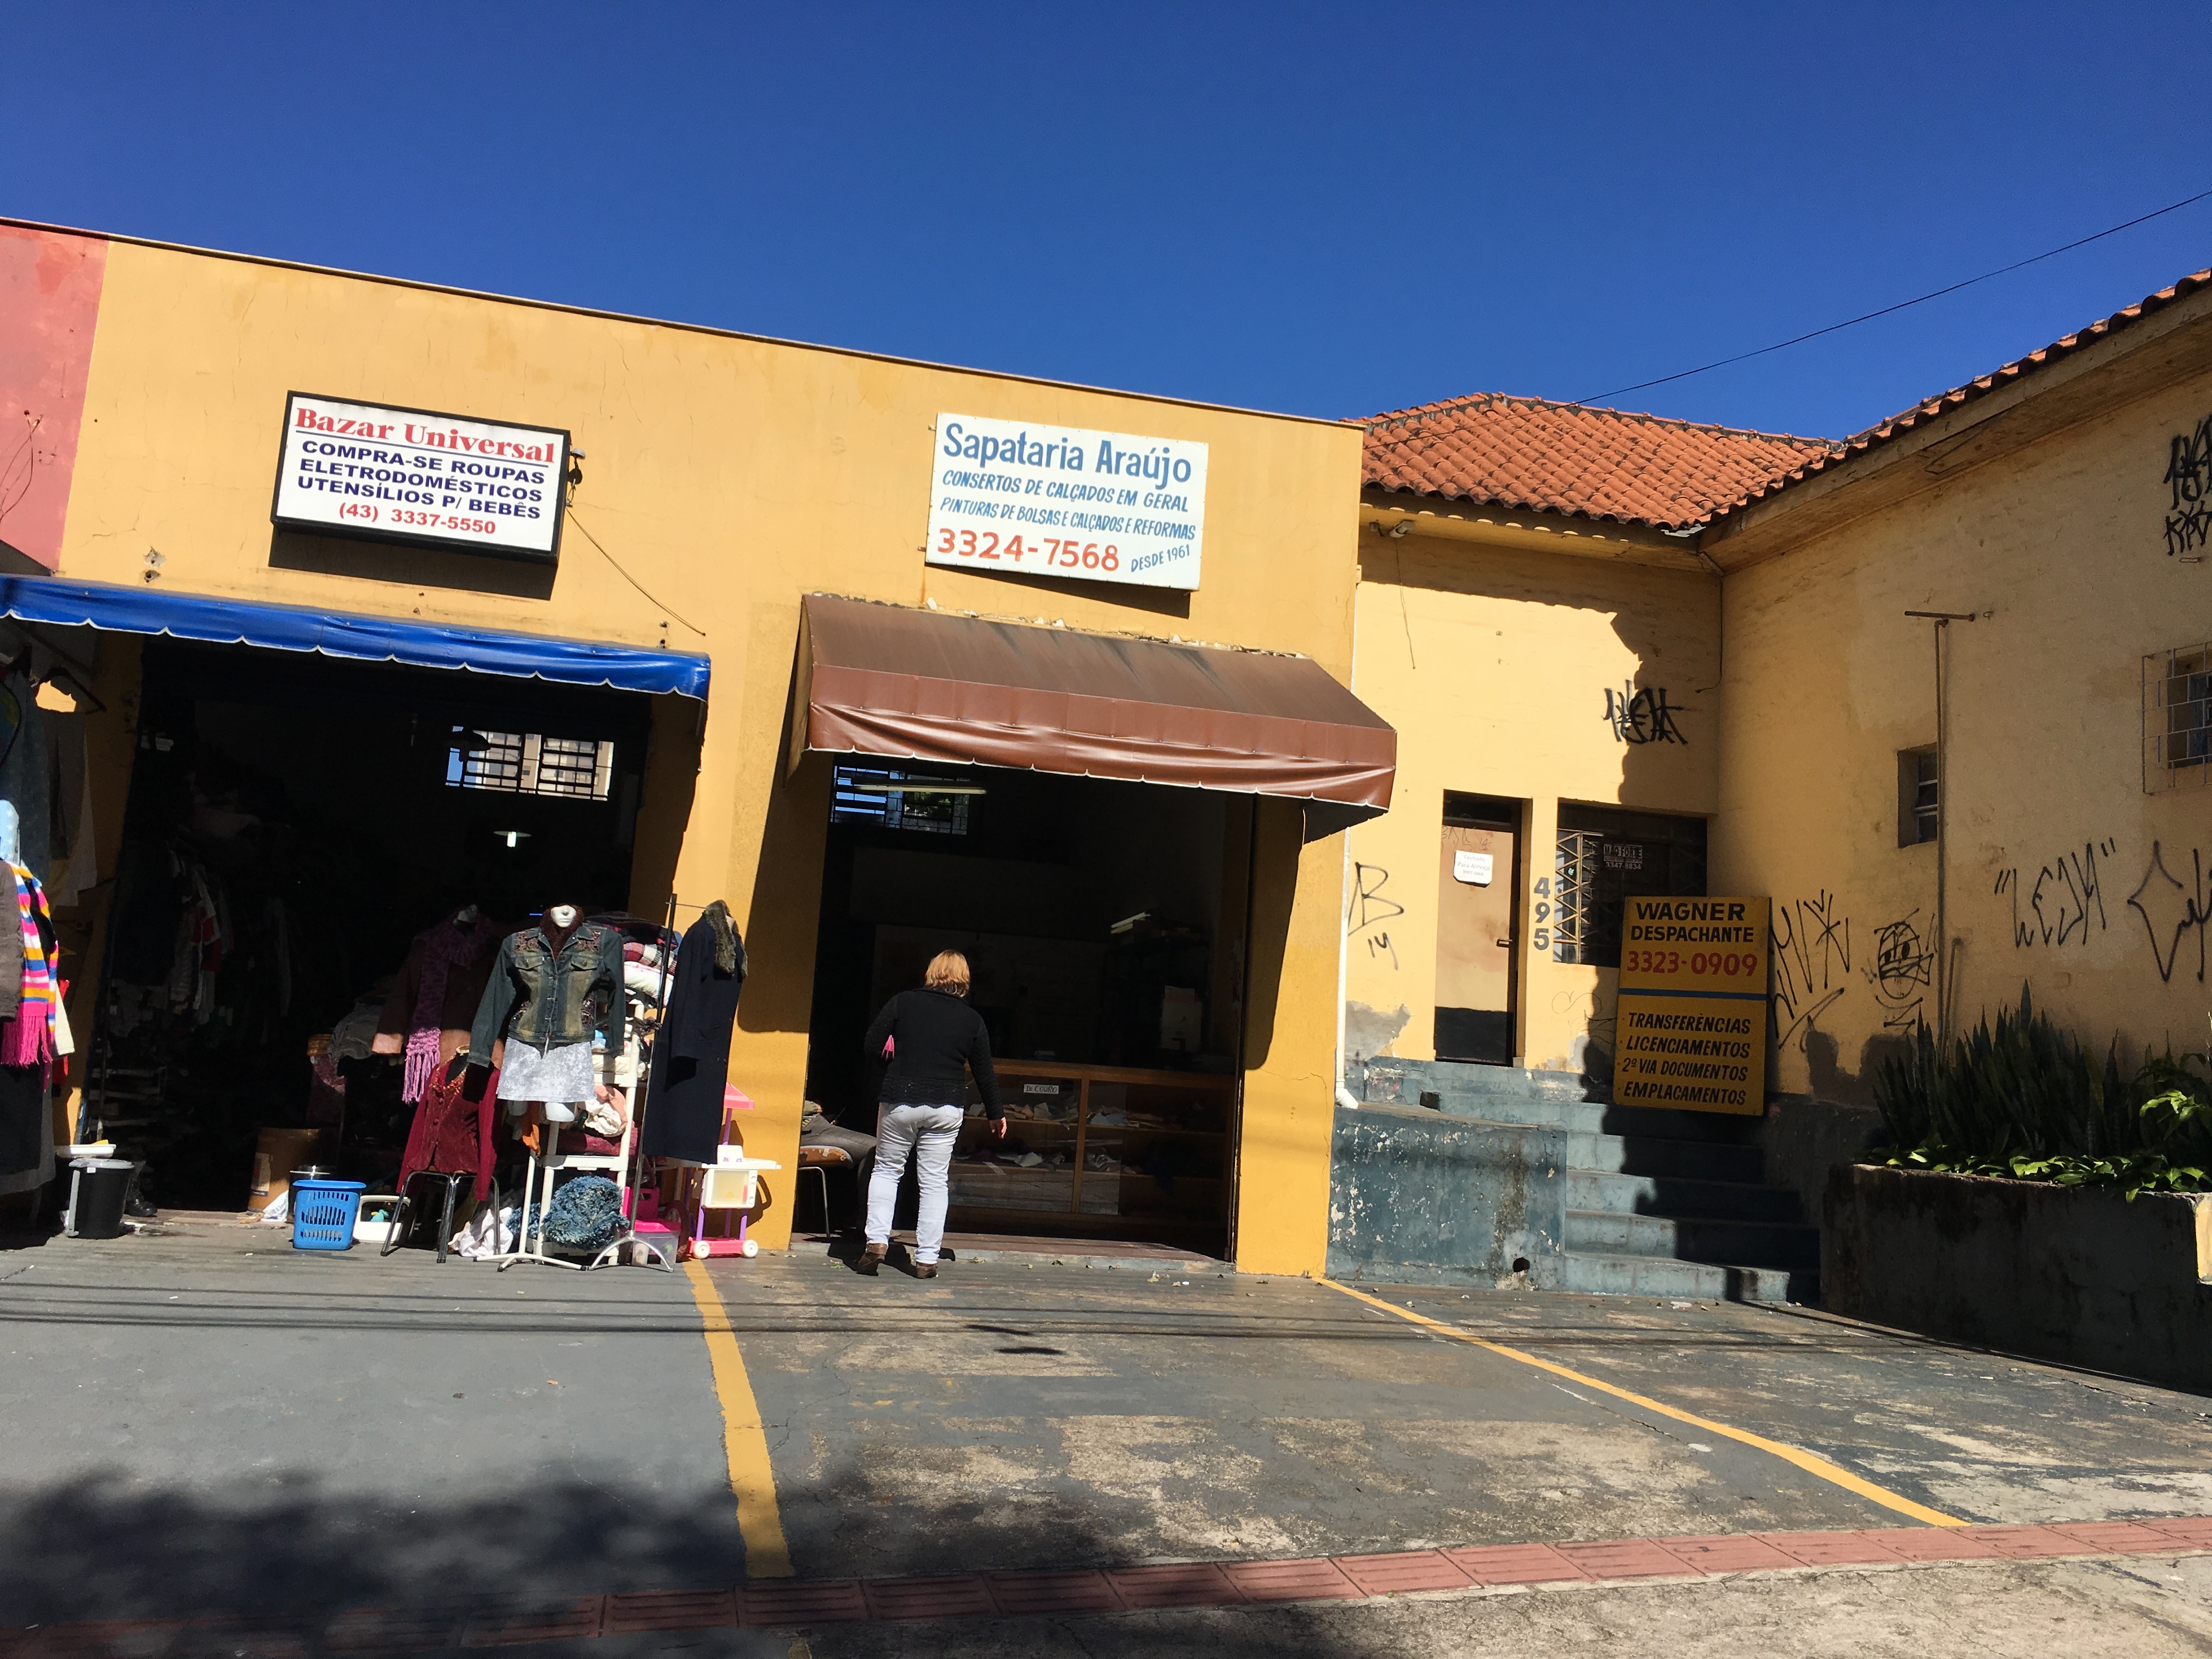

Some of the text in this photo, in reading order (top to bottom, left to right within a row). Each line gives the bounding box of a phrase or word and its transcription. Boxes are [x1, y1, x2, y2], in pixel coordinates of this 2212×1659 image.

[295, 408, 555, 463] Bazar Universal
[302, 441, 544, 484] COMPRA-SE ROUPAS
[944, 423, 1191, 489] Sapataria Araújo
[300, 459, 542, 502] ELETRODOMÉSTICOS
[943, 470, 1188, 512] CONSERTOS DE CALÇADOS EM GERAL
[298, 476, 540, 519] UTENSÍLIOS P/ BEBÊS
[339, 503, 495, 534] (43) 3337-5550
[940, 497, 1195, 540] PINTURAS DE BOLSAS E CALÇADOS E REFORMAS
[938, 528, 1119, 572] 3324-7568
[1131, 545, 1190, 572] DESDE 1961
[1636, 902, 1746, 921] WAGNER
[1630, 926, 1754, 943] DESPACHANTE
[1627, 951, 1758, 977] 3323-0909
[1628, 1012, 1751, 1034] TRANSFERÊNCIAS
[1626, 1035, 1750, 1059] LICENCIAMENTOS
[1639, 1058, 1657, 1074] VIA
[1660, 1060, 1748, 1082] DOCUMENTOS
[1624, 1081, 1746, 1105] EMPLACAMENTOS
